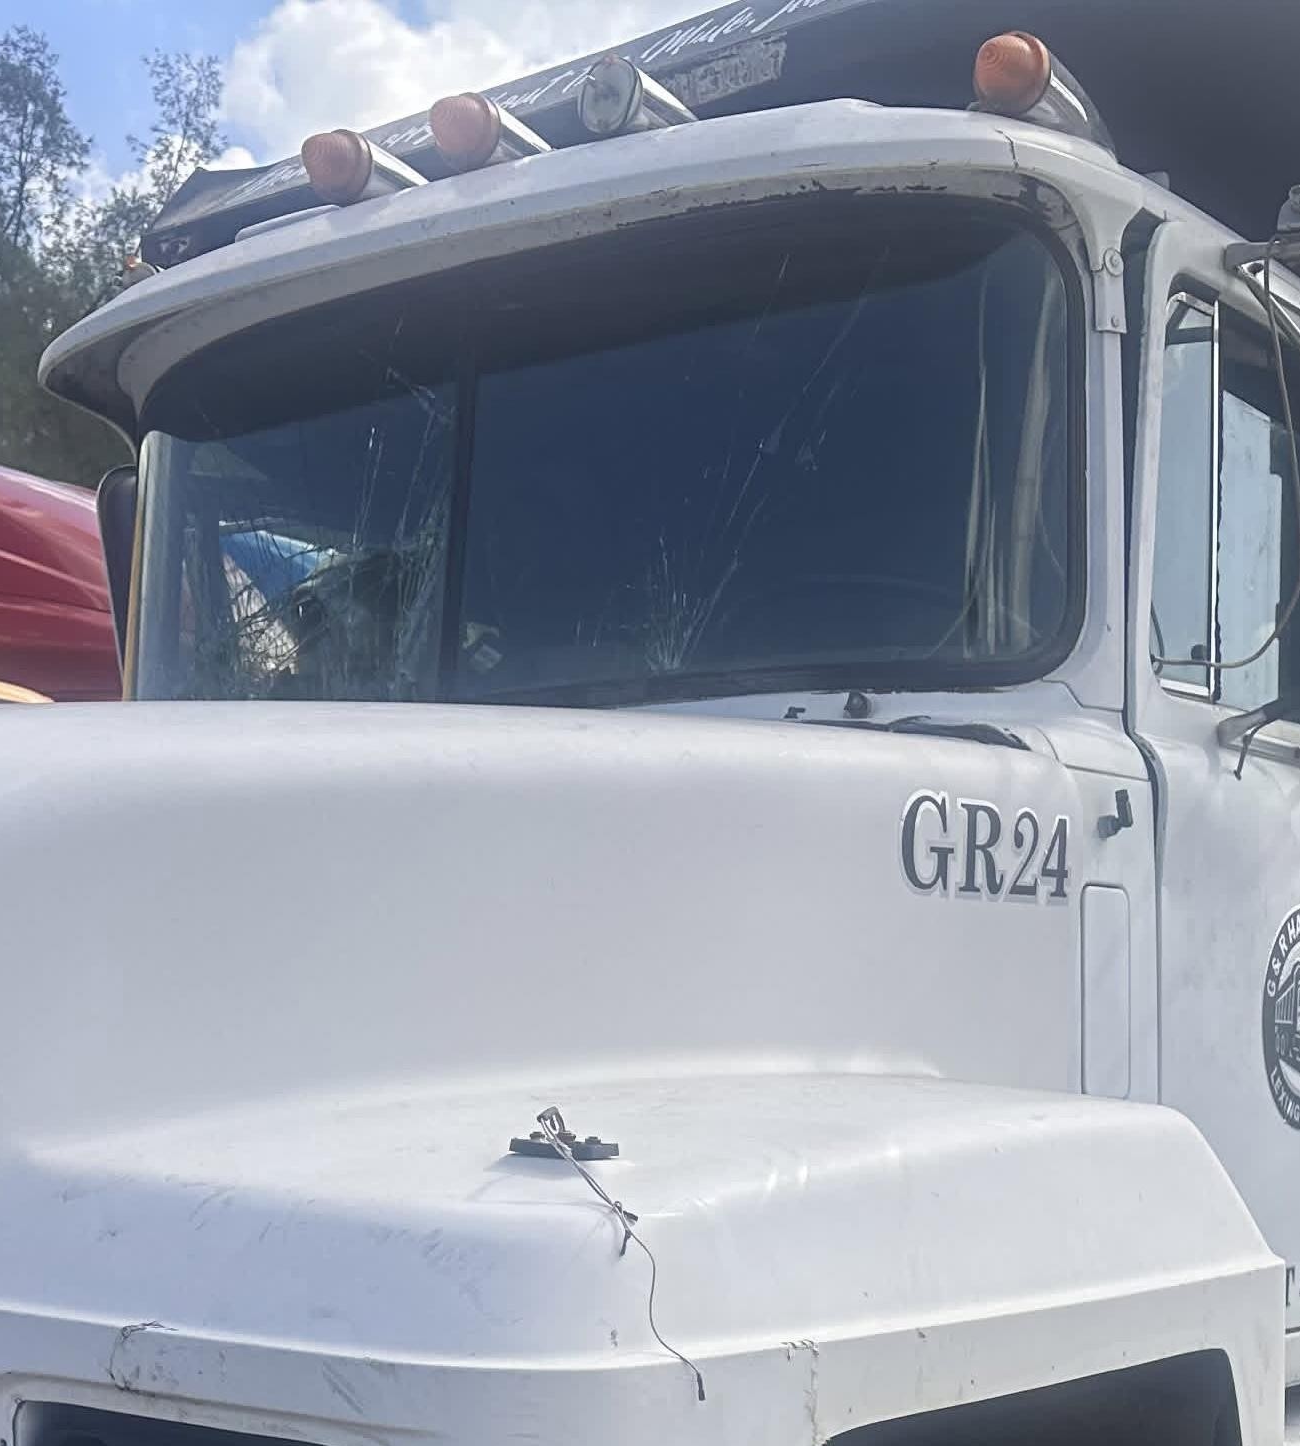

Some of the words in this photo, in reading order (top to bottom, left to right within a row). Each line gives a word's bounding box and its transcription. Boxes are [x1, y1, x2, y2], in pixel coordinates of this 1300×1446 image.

[900, 792, 1070, 899] GR24
[1267, 980, 1276, 997] G
[1272, 958, 1282, 976] &
[1279, 933, 1288, 957] R
